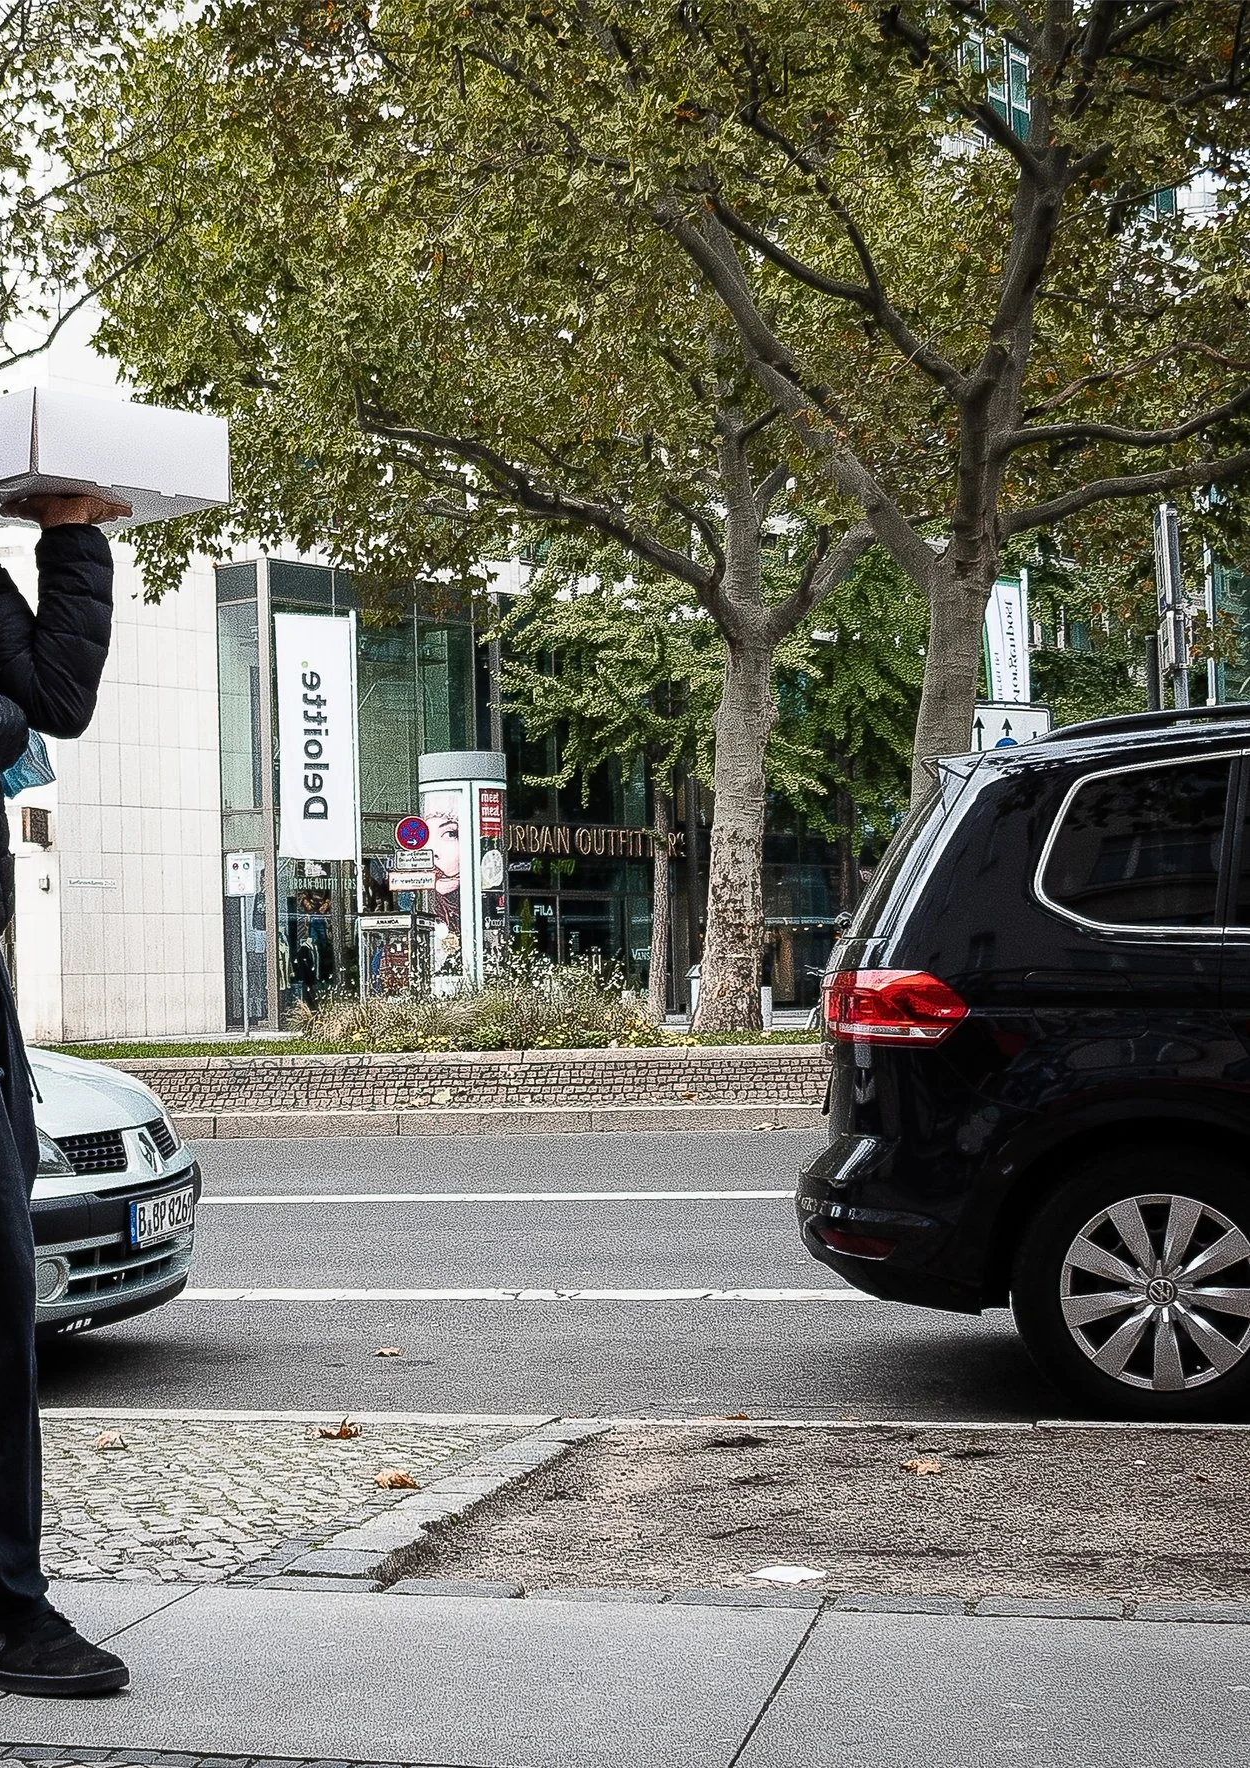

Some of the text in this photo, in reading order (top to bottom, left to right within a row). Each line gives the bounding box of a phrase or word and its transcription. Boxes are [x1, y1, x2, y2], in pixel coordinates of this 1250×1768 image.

[533, 905, 554, 916] FILA
[138, 1206, 146, 1237] B
[152, 1201, 166, 1232] BP
